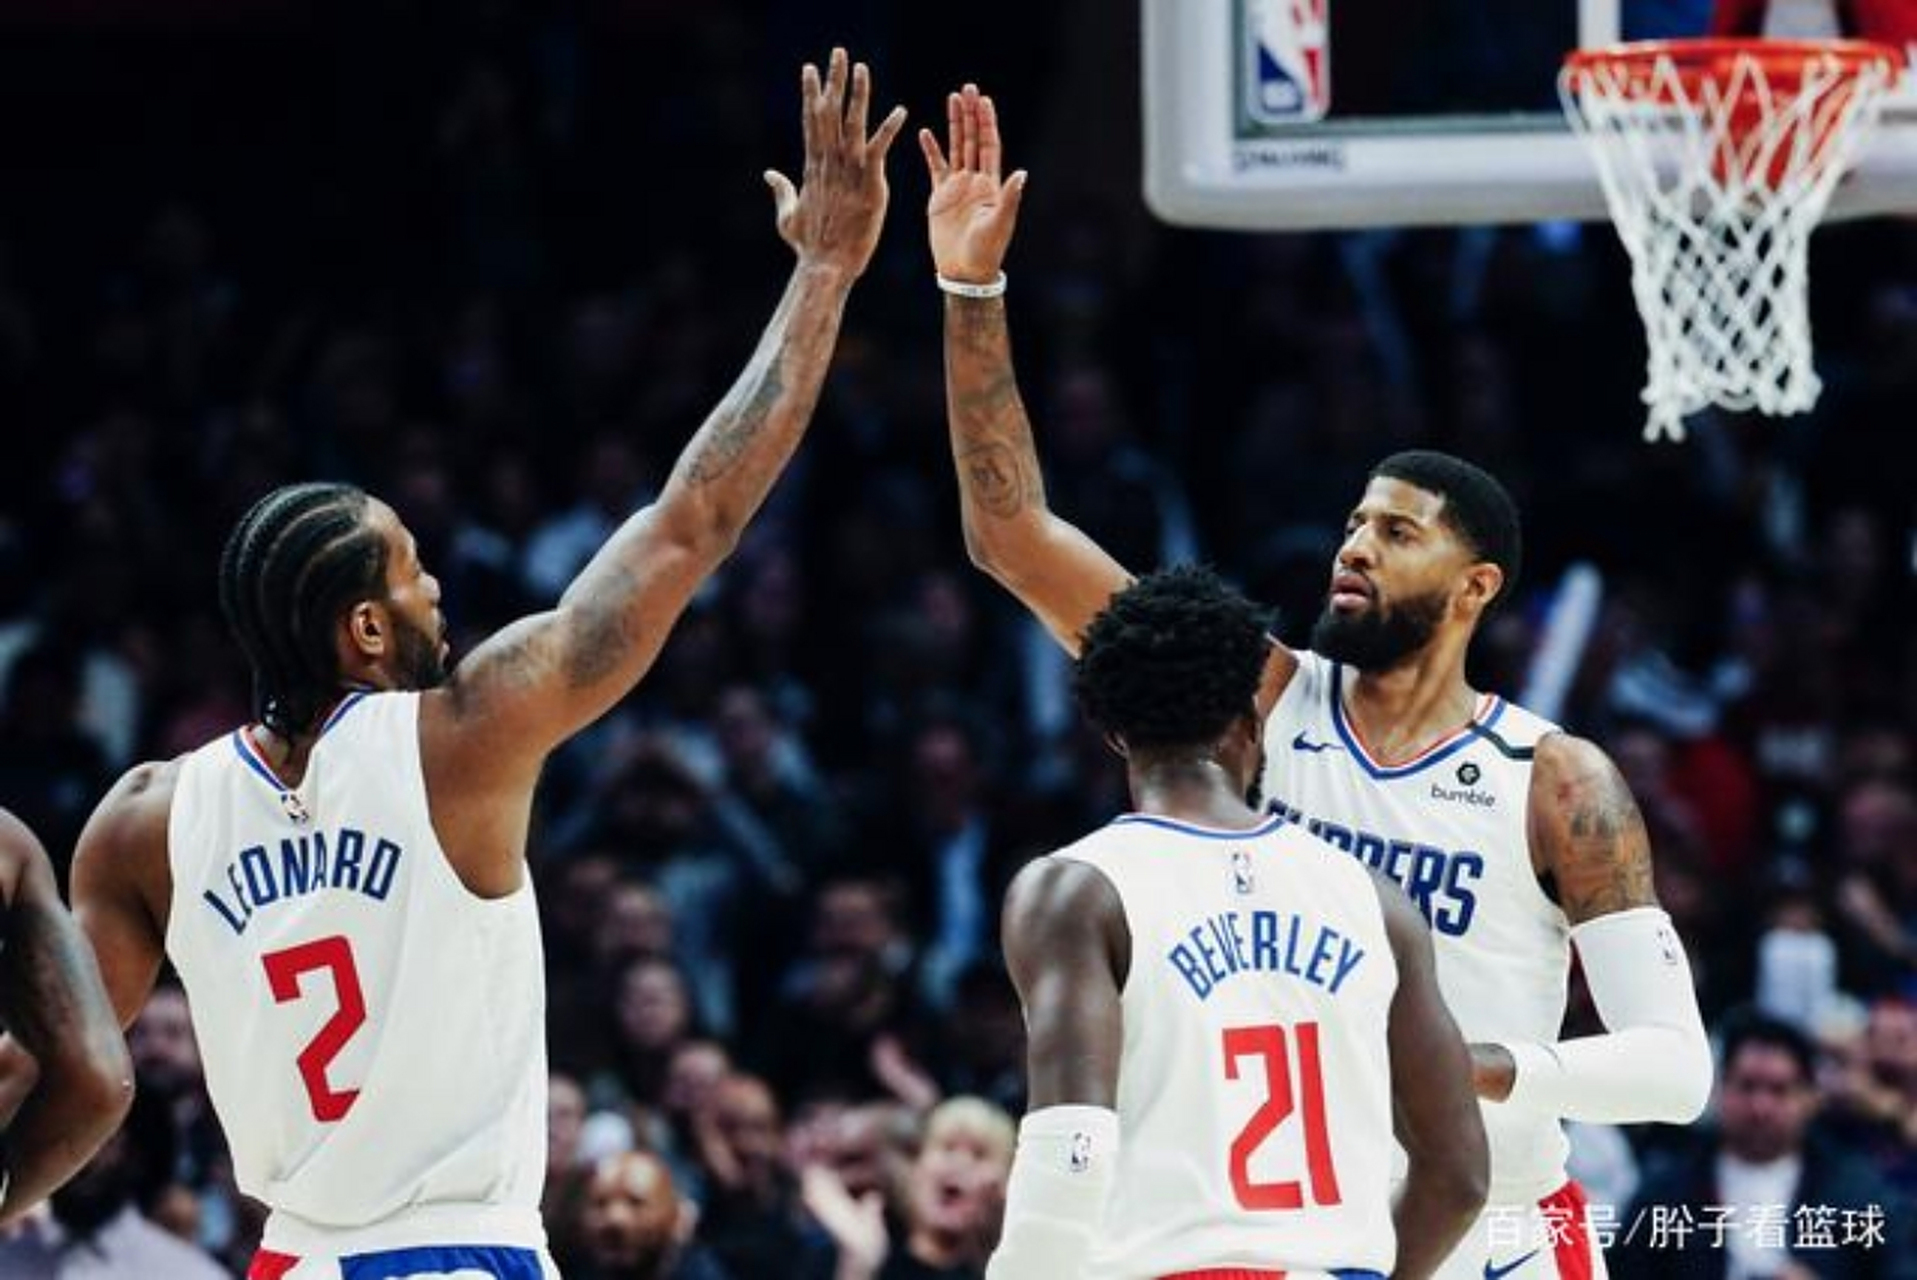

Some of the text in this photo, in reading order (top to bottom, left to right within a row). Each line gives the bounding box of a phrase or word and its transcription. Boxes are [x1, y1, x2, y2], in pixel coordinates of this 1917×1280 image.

[1430, 782, 1496, 807] bumble
[203, 828, 402, 935] LEONARD
[1168, 910, 1364, 1001] BEVERLEY
[261, 935, 366, 1122] 2
[1222, 1021, 1342, 1211] 21
